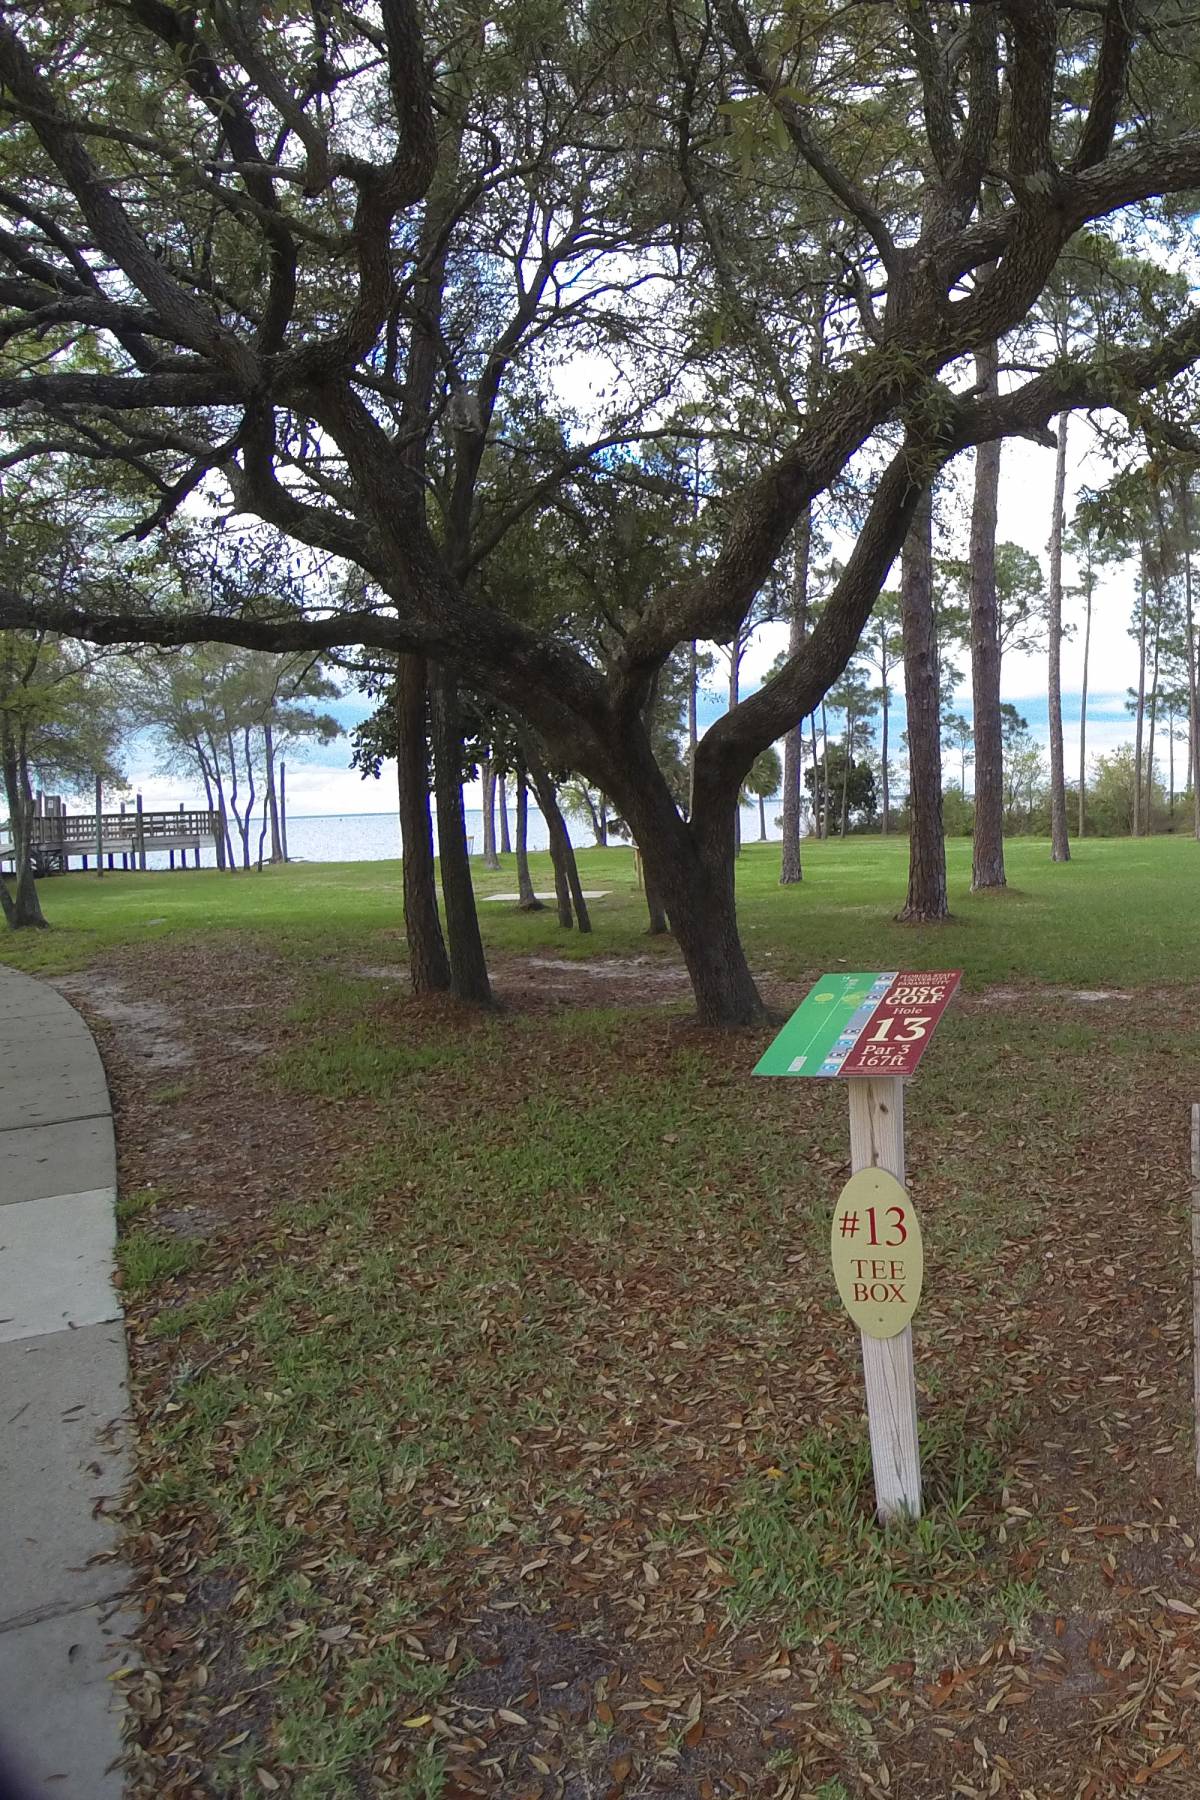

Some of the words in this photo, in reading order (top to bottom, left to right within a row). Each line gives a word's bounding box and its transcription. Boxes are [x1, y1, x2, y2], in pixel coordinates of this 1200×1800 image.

[892, 986, 945, 996] DISC
[886, 995, 945, 1005] GOLF
[866, 1017, 932, 1041] 13
[862, 1045, 895, 1055] Par
[898, 1045, 911, 1054] 3
[857, 1055, 905, 1066] 167ft
[839, 1206, 907, 1246] #13
[850, 1259, 906, 1280] TEE
[852, 1283, 907, 1303] BOX
